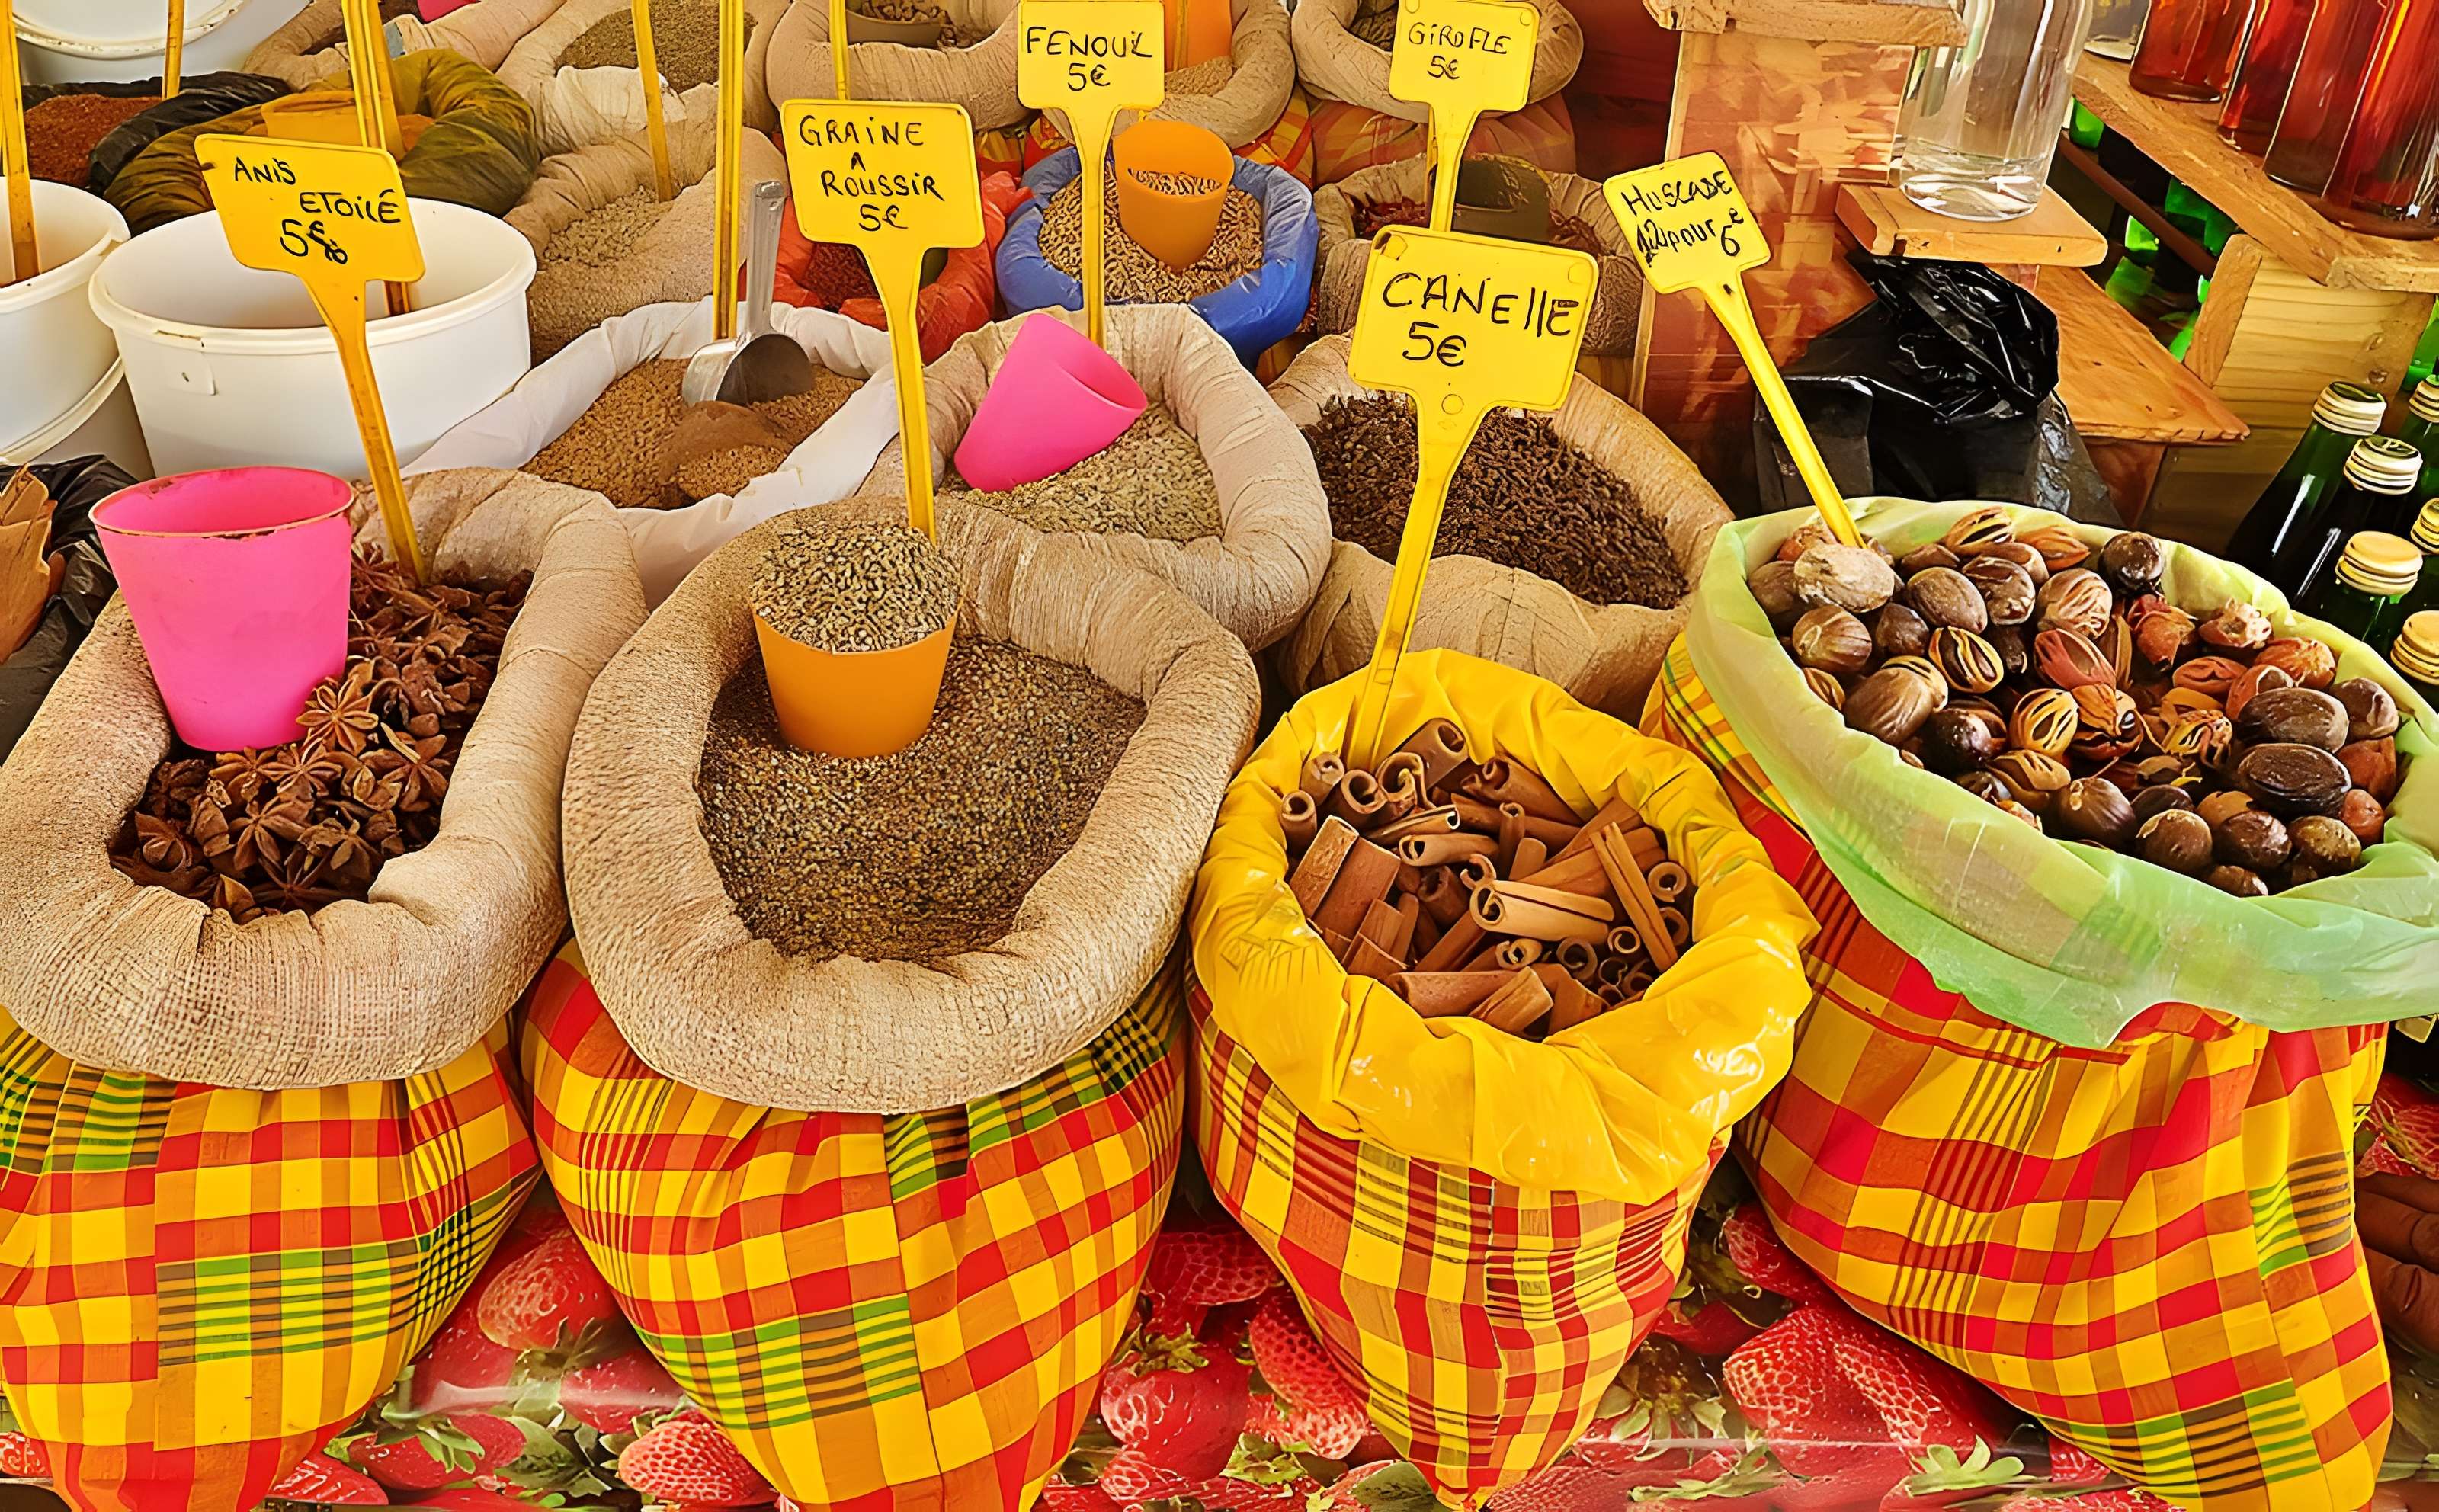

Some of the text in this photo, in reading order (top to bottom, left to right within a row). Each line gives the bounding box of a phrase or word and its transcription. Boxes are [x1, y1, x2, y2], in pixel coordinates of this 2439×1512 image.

[1068, 62, 1111, 91] 5€
[1427, 55, 1460, 80] 5€
[858, 203, 909, 232] 5€
[1402, 321, 1467, 367] 5€
